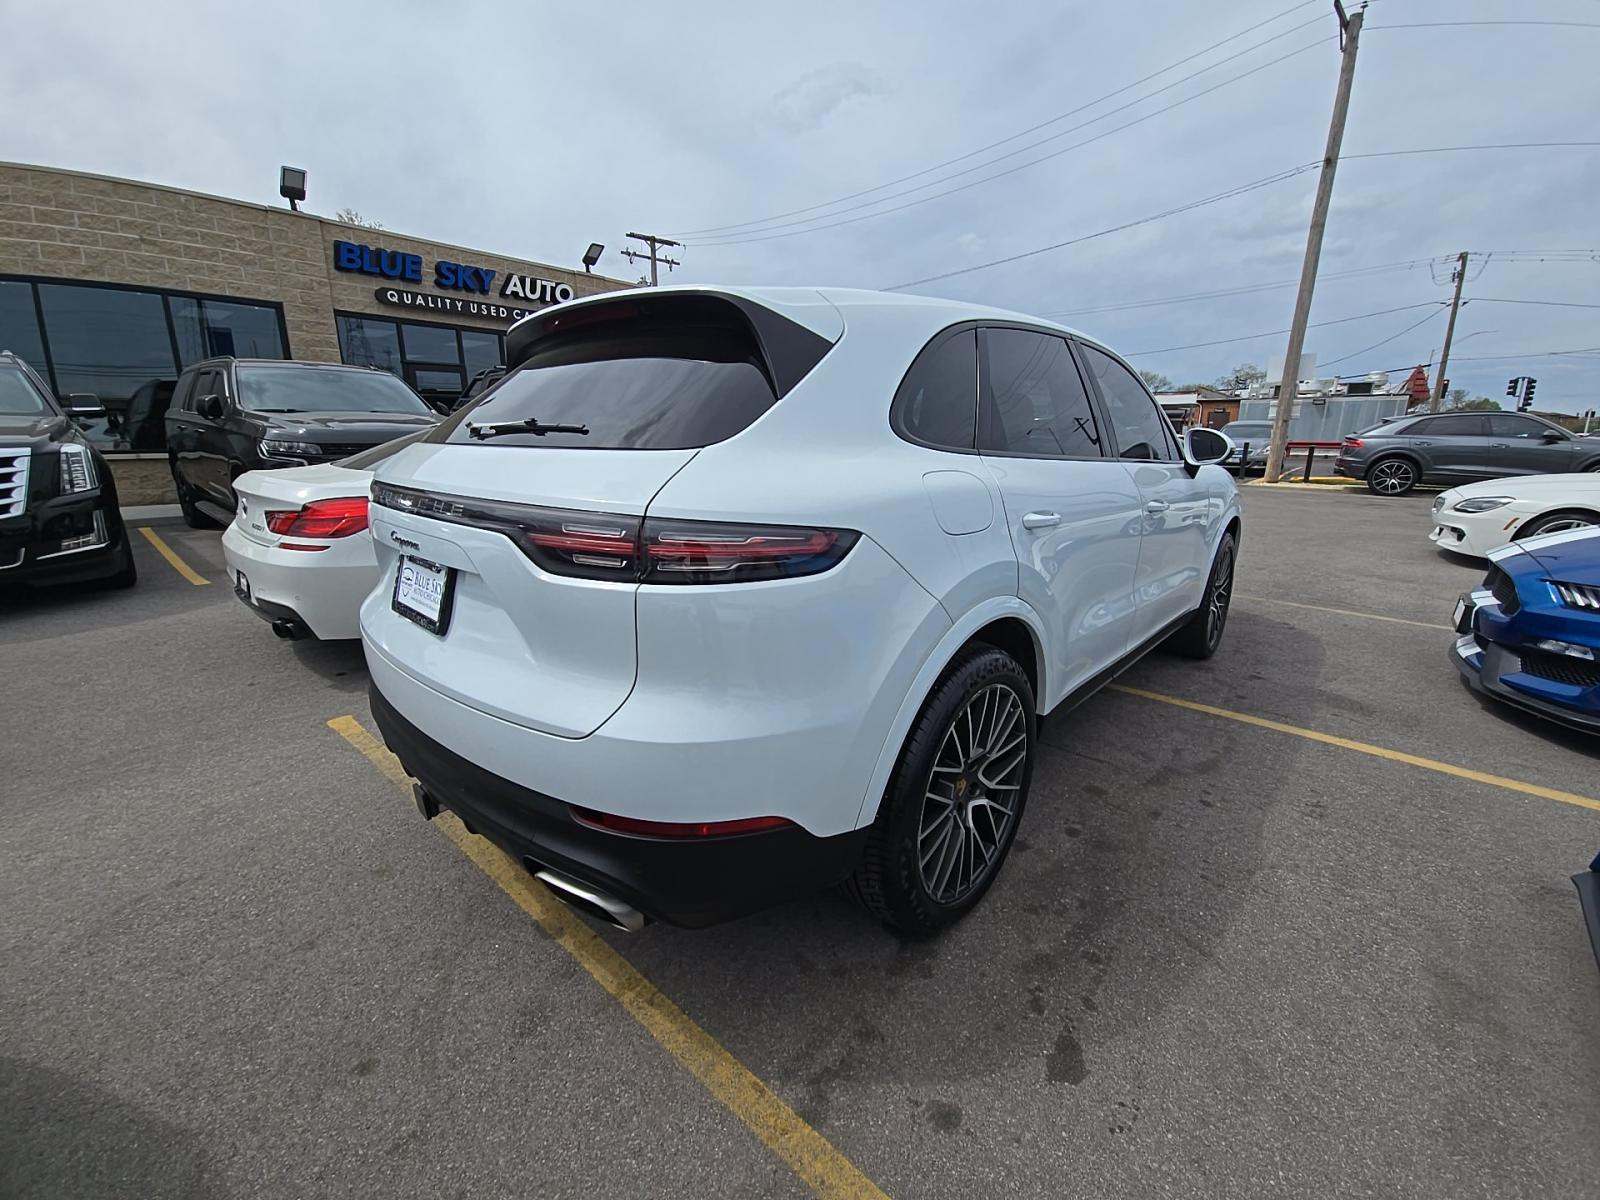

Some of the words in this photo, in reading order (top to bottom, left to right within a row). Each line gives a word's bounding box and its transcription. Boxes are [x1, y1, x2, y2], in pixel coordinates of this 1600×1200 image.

[335, 240, 423, 284] BLUE
[435, 260, 497, 294] SKY
[505, 273, 575, 303] AUTO
[386, 289, 464, 312] QUALITY
[470, 303, 508, 319] USED
[512, 309, 531, 320] CA
[414, 571, 431, 591] BLUE
